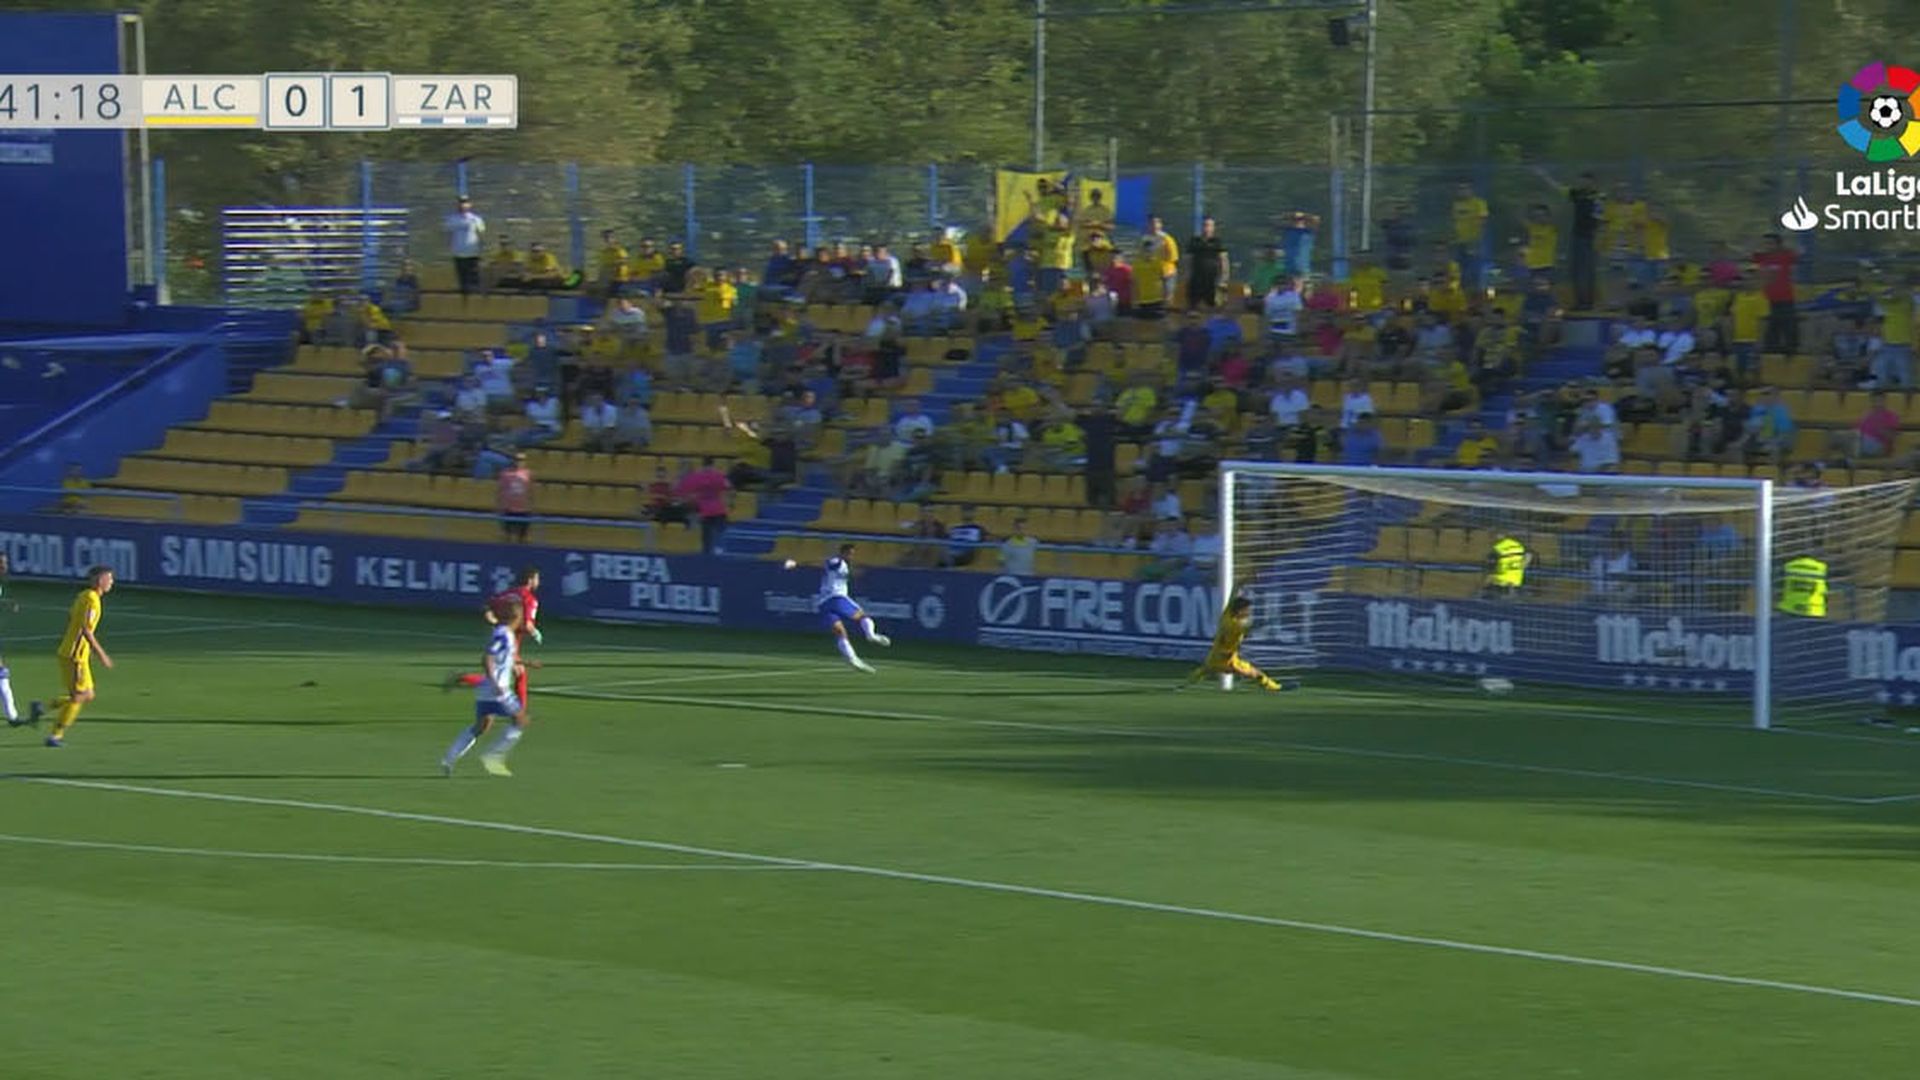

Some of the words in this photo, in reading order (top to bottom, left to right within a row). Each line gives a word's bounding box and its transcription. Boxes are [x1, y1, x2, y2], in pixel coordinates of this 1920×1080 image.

[161, 535, 332, 587] SAMSUNG
[357, 556, 481, 593] KELME
[591, 553, 671, 583] REPA
[630, 582, 721, 613] PUBLI
[1041, 579, 1123, 632] FIRE
[1367, 602, 1515, 655] Mahou
[1596, 615, 1756, 671] Mahou
